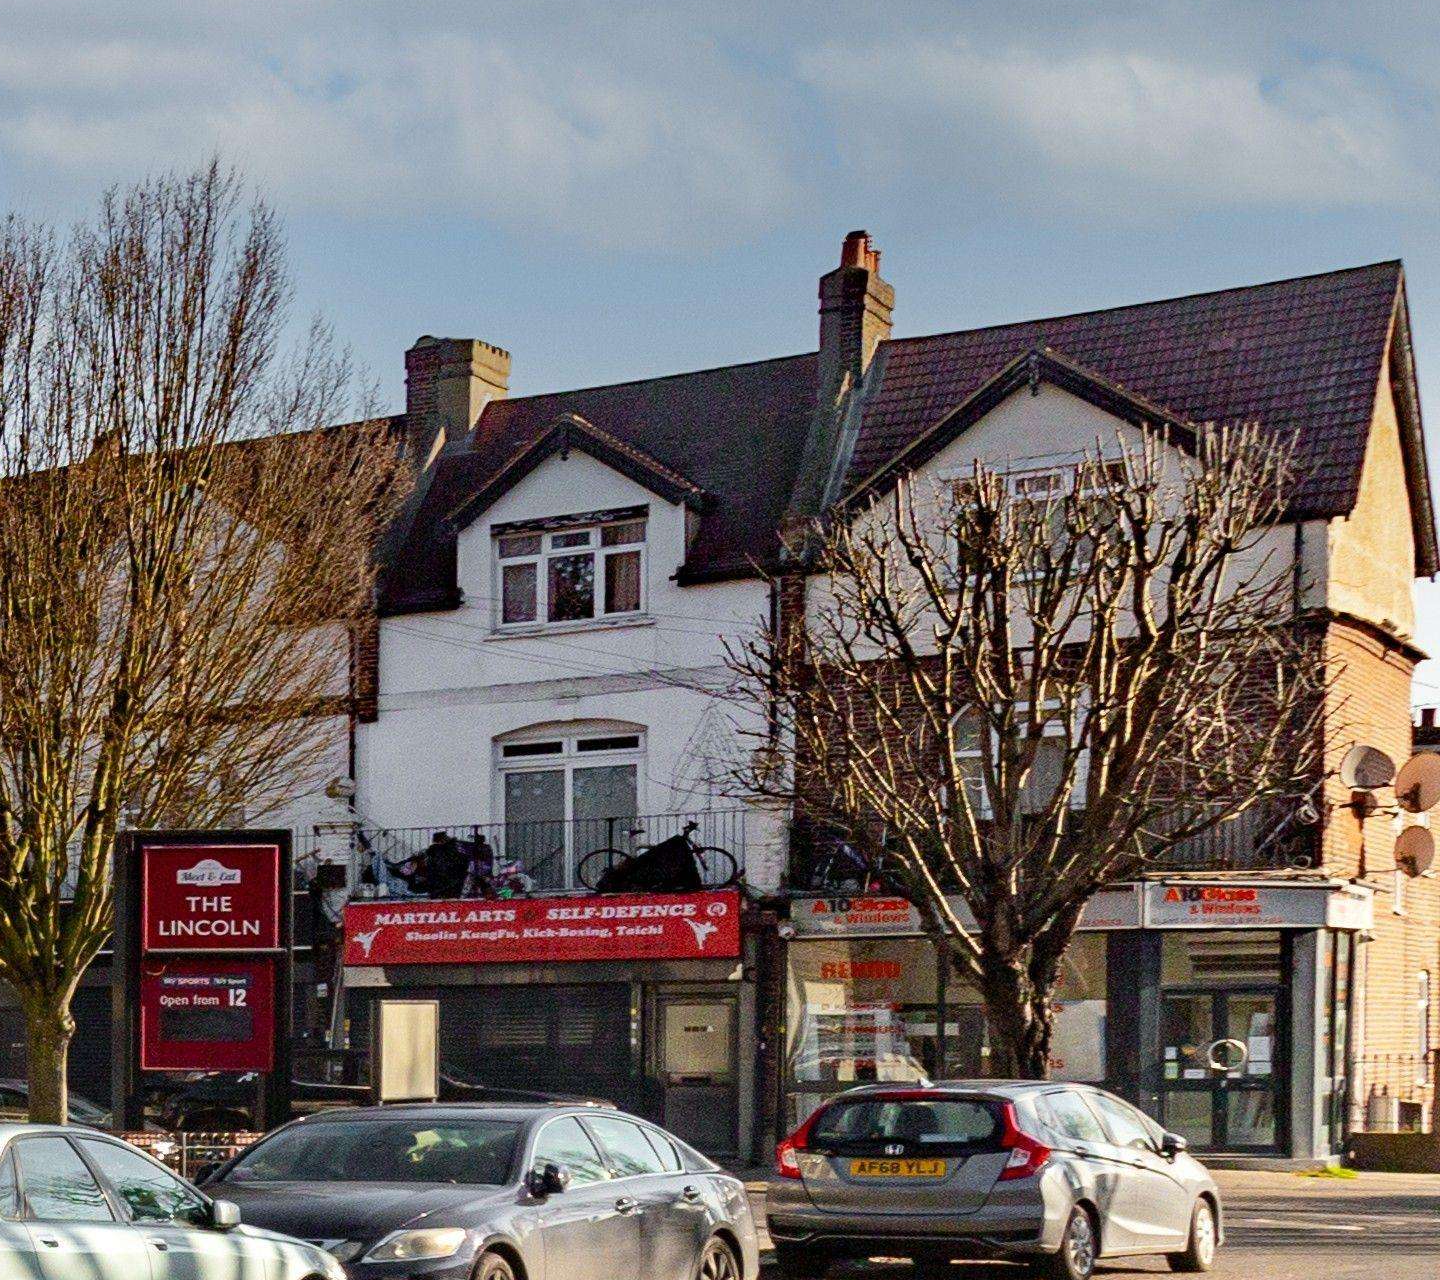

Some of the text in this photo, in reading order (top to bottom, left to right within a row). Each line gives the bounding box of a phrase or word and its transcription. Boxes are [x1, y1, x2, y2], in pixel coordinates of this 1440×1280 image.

[185, 896, 232, 912] THE
[374, 903, 697, 926] MARTIAL ARTS SELF-DEFENCE
[158, 919, 260, 936] LINCOLN
[159, 988, 247, 1007] Open from 12
[858, 1160, 940, 1174] AF68 YLJ
